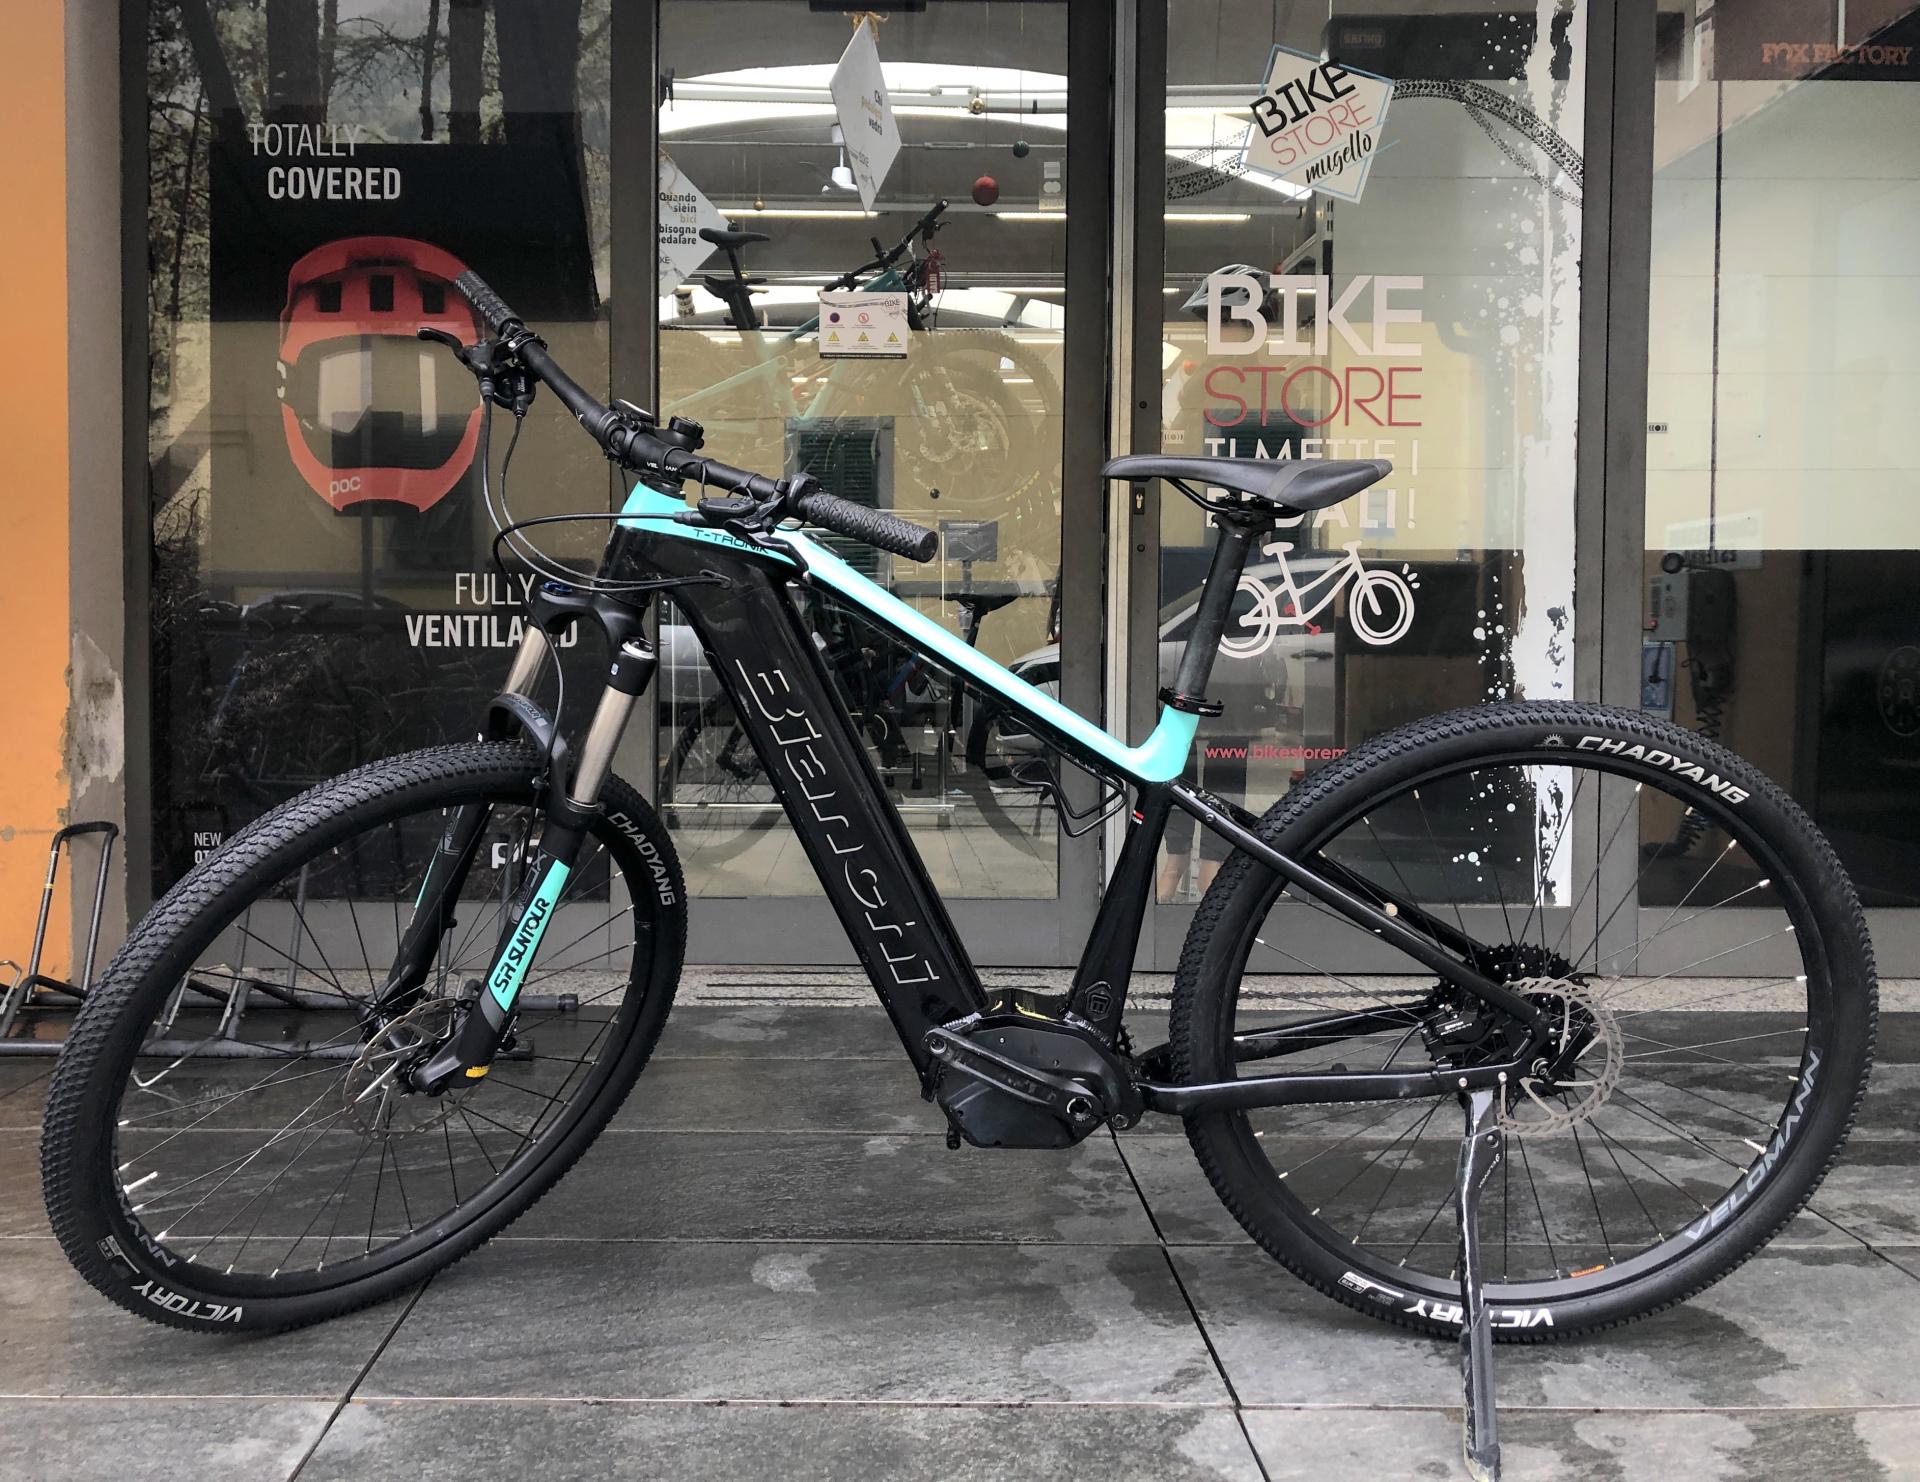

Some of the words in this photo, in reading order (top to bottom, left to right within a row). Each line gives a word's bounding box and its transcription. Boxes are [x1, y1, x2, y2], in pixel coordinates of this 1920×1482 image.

[1761, 42, 1809, 64] FOX
[1813, 43, 1912, 65] FACTORY
[1249, 58, 1356, 138] BIKE
[251, 123, 360, 157] TOTALLY
[1271, 94, 1373, 165] STORE
[1306, 130, 1373, 184] mugello
[268, 167, 401, 200] COVERED
[659, 192, 696, 202] Quando
[659, 224, 696, 236] bisogna
[1207, 274, 1424, 357] BIKE
[1203, 366, 1423, 427] STORE
[455, 573, 536, 605] FULLY
[405, 615, 578, 648] VENTILAD
[1575, 735, 1750, 804] CHAOYANG
[194, 832, 221, 847] NEW
[607, 812, 676, 906] CHAOYANG
[494, 962, 516, 993] SR
[508, 897, 551, 967] SUNTOUR
[1684, 1049, 1820, 1240] VELOMANN
[131, 1280, 243, 1323] VICTORY
[1403, 1299, 1554, 1328] VICRY
